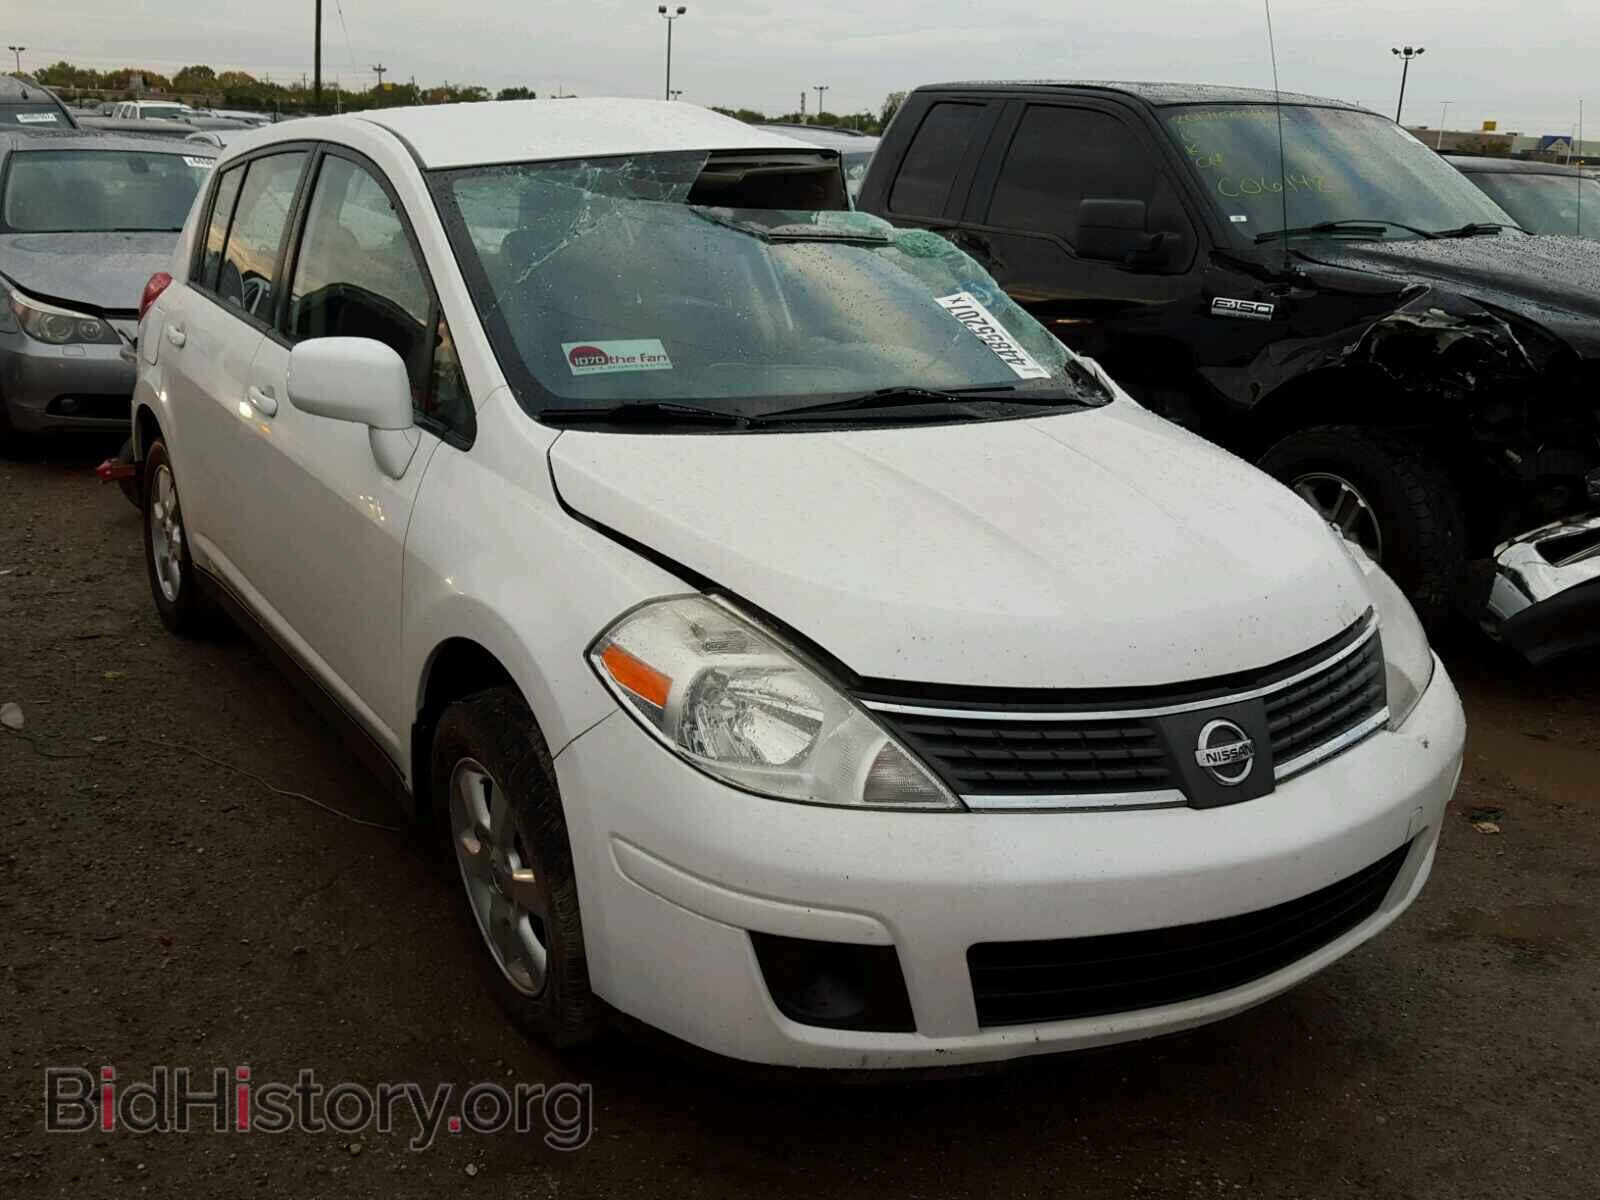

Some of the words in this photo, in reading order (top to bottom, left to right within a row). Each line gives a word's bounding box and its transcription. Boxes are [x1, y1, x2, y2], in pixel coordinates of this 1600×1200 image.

[608, 355, 636, 365] the
[640, 353, 667, 364] fan
[1205, 742, 1254, 764] NISSAN
